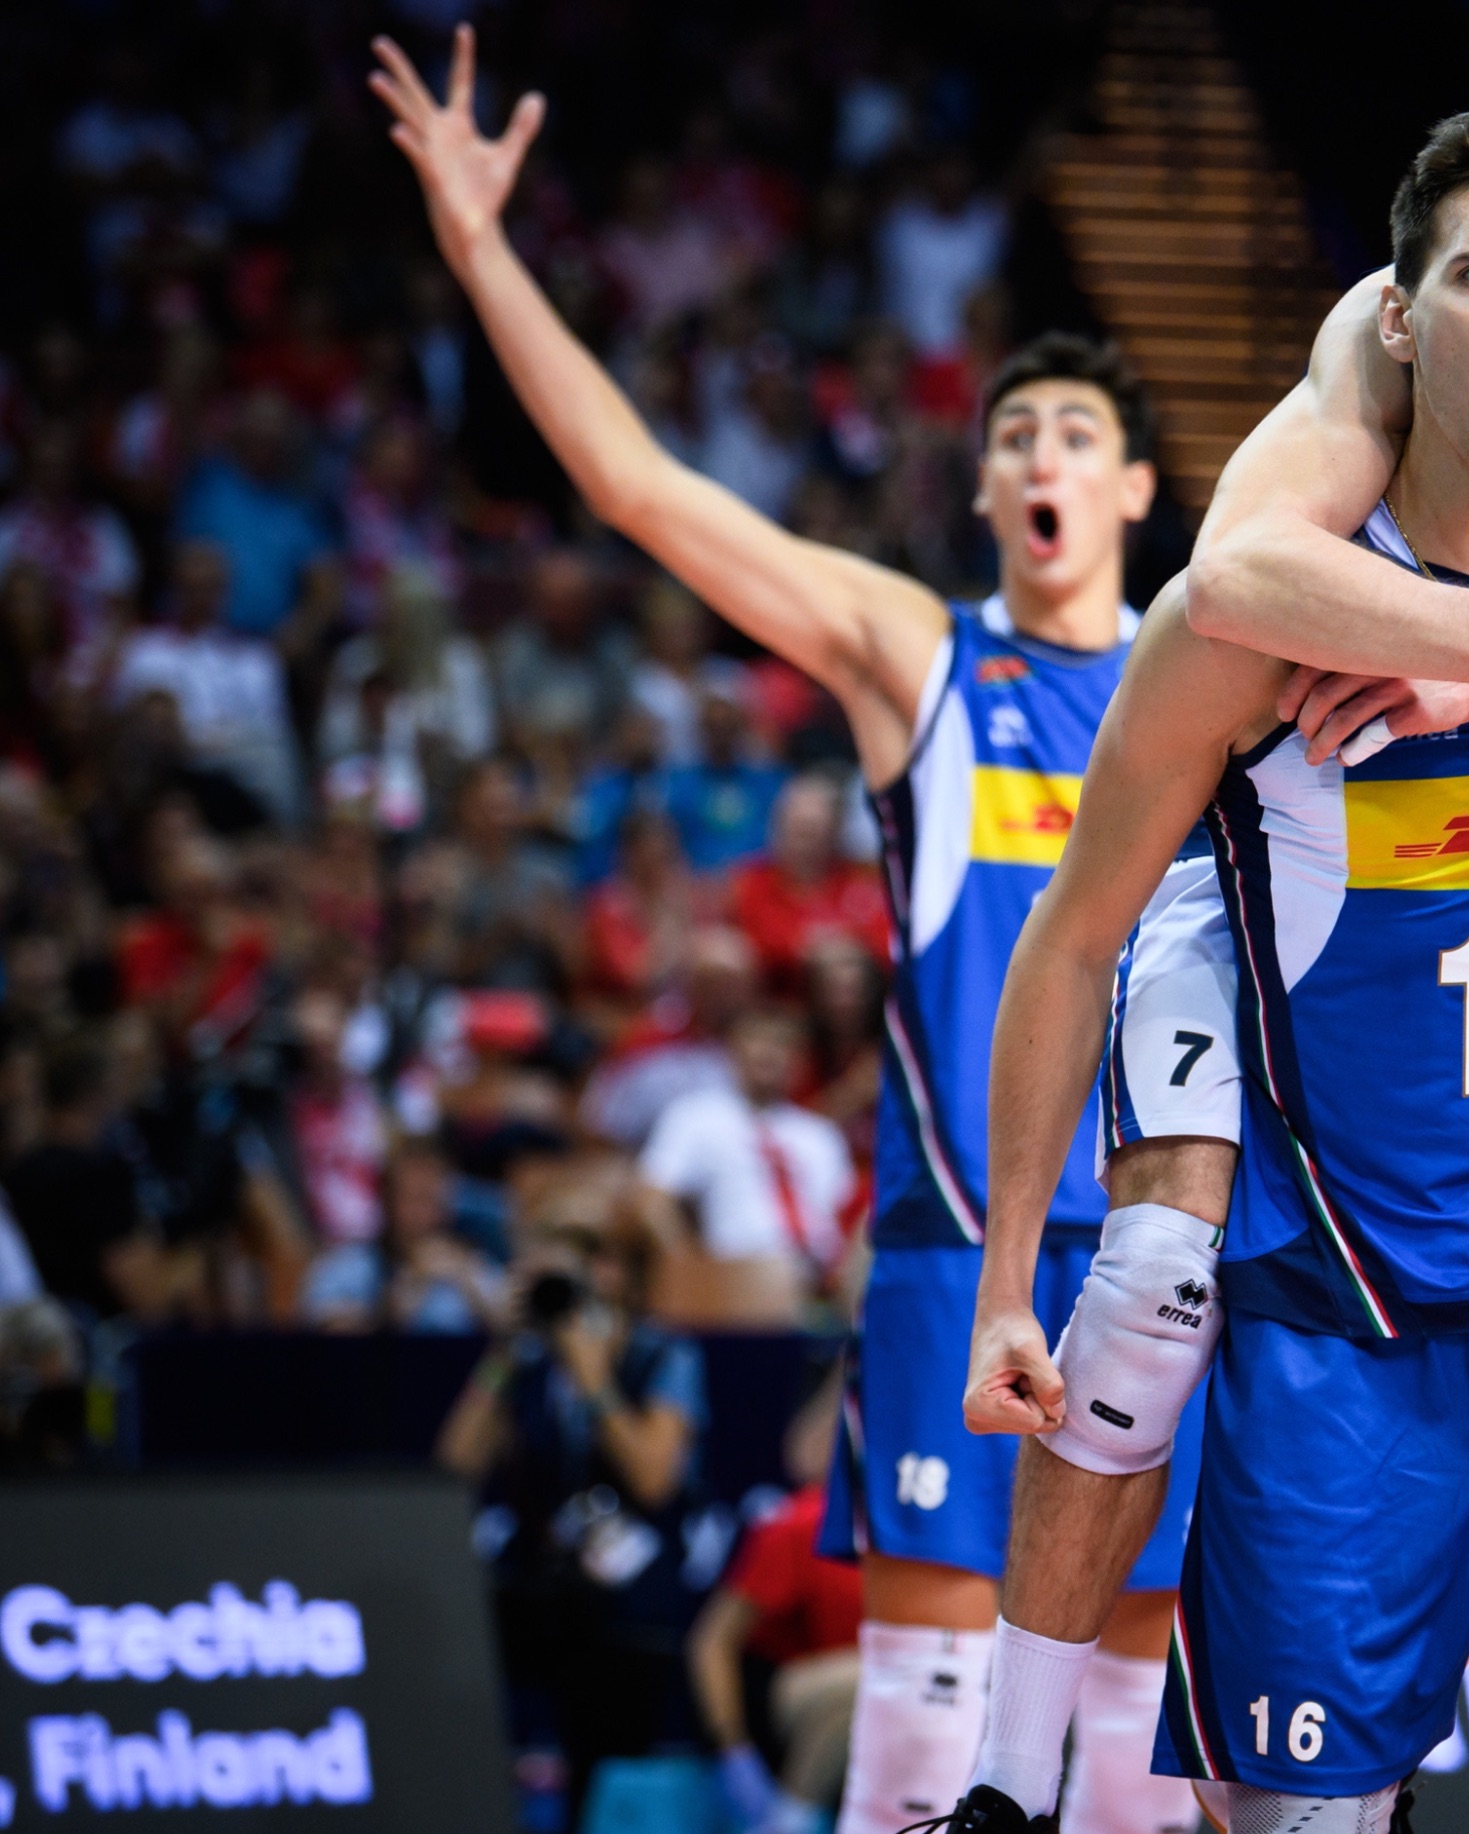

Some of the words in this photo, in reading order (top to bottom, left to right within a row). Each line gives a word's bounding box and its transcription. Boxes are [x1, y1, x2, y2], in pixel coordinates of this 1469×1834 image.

[1169, 1030, 1214, 1087] 7
[1156, 1304, 1203, 1330] errea
[896, 1450, 950, 1511] 18
[0, 1580, 366, 1684] Czechia
[28, 1706, 373, 1812] Finland
[1249, 1695, 1327, 1762] 16
